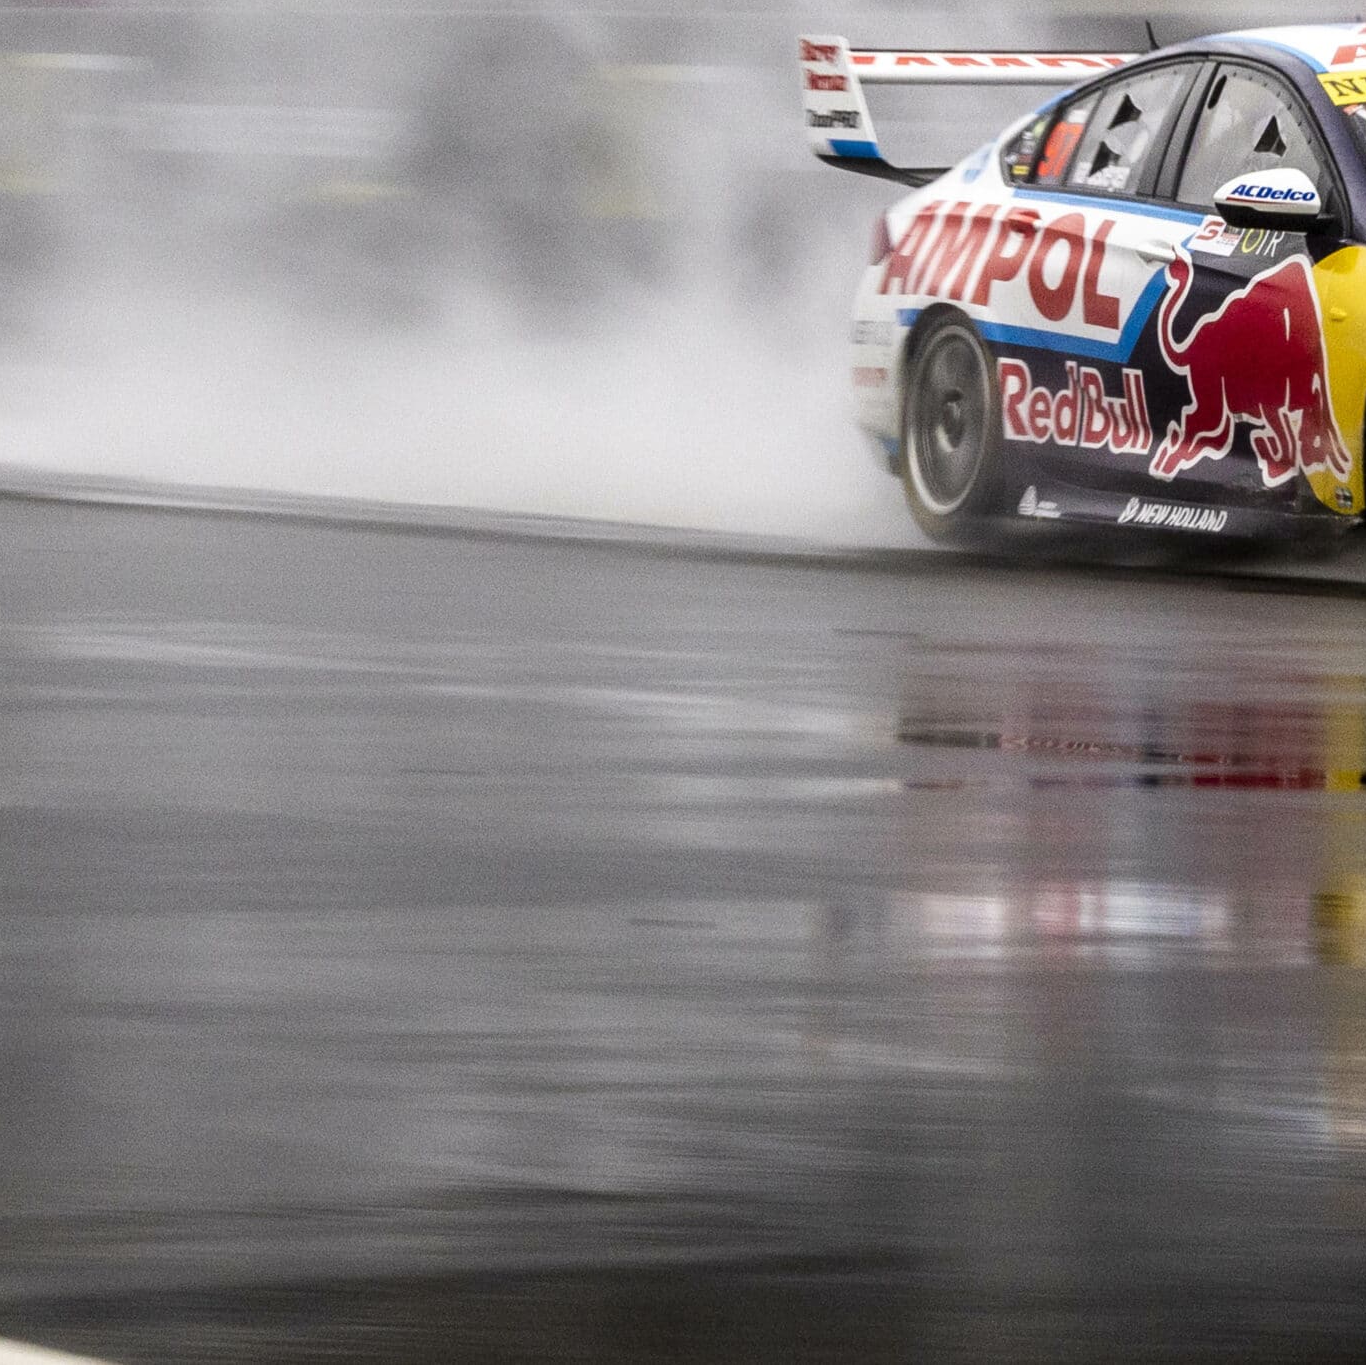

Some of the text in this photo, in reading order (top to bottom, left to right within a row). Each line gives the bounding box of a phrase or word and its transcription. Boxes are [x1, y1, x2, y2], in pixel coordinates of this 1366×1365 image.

[1230, 184, 1316, 202] ACDelco
[877, 199, 1122, 331] AMPOL
[997, 356, 1153, 454] Red Bull
[1134, 503, 1228, 533] NEW HOLLAND
